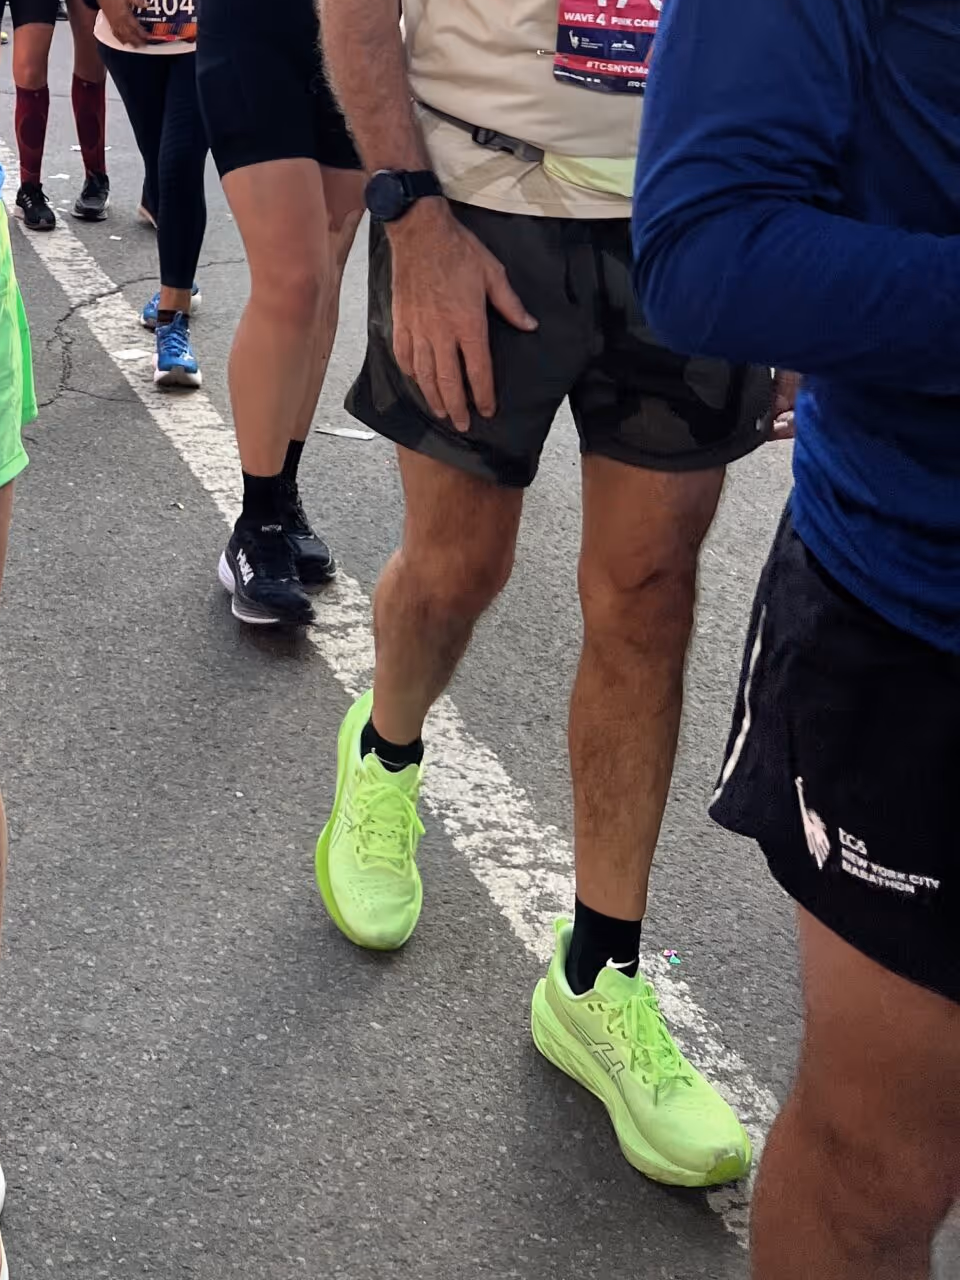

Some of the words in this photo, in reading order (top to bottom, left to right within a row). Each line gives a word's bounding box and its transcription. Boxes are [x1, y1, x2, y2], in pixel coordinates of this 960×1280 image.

[563, 12, 594, 23] WAVE
[595, 13, 606, 26] 4
[610, 16, 633, 26] PINK
[838, 827, 868, 855] tcs
[841, 859, 915, 894] MARATHON
[908, 874, 940, 889] CITY
